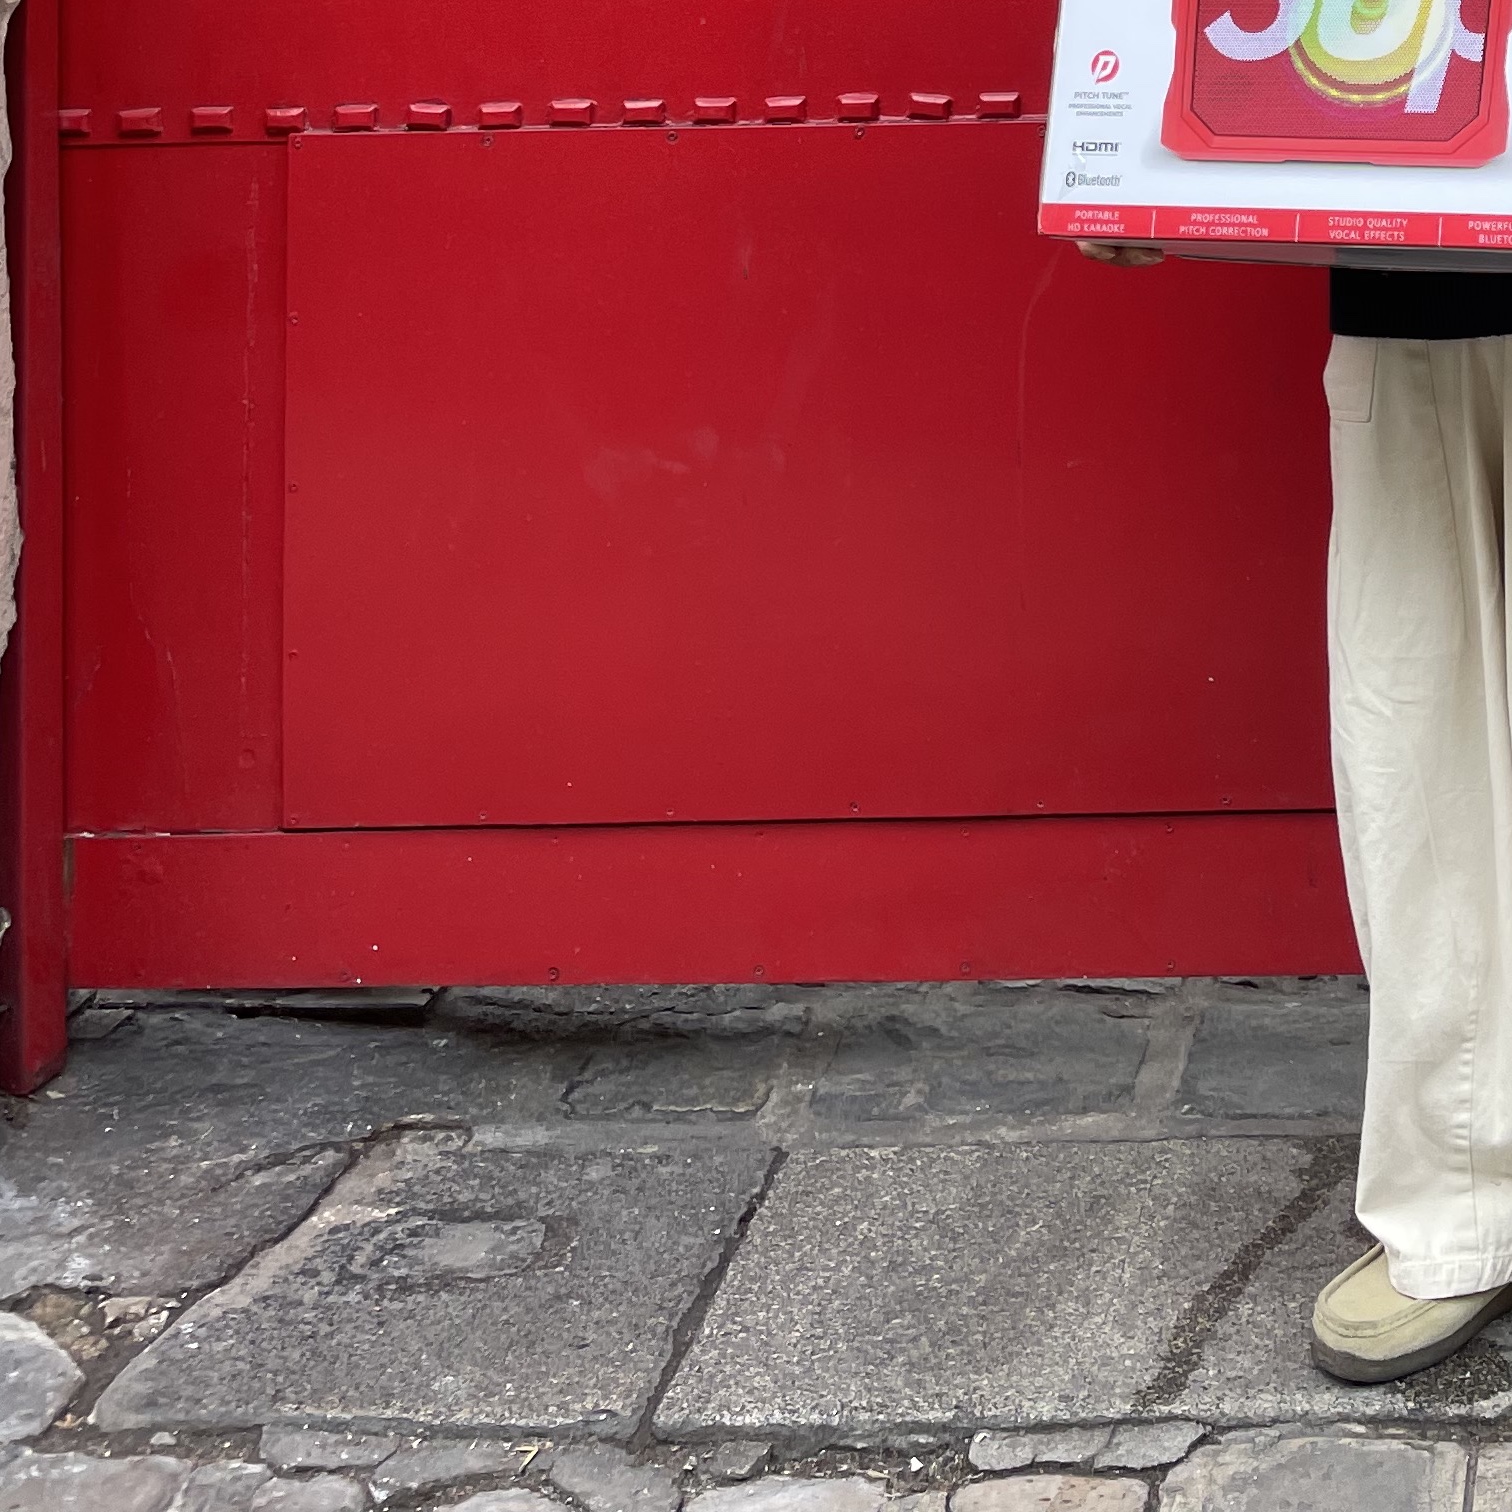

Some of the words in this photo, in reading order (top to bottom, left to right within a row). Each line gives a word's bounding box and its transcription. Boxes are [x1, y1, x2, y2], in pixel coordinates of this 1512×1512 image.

[1074, 91, 1099, 100] PITCH
[1072, 141, 1120, 152] HDMI
[1077, 173, 1121, 187] Bluetooth
[1074, 209, 1120, 221] PORTABLE
[1190, 213, 1258, 224] PROFESSIONAL
[1067, 222, 1081, 232] HD
[1083, 223, 1126, 233] KARAOKE
[1328, 216, 1364, 227] STUDIO
[1366, 217, 1408, 229] QUALITY
[1179, 225, 1206, 236] PITCH
[1209, 226, 1269, 237] CORRECTION
[1329, 229, 1361, 240] VOCAL
[1364, 230, 1406, 241] EFFECTS
